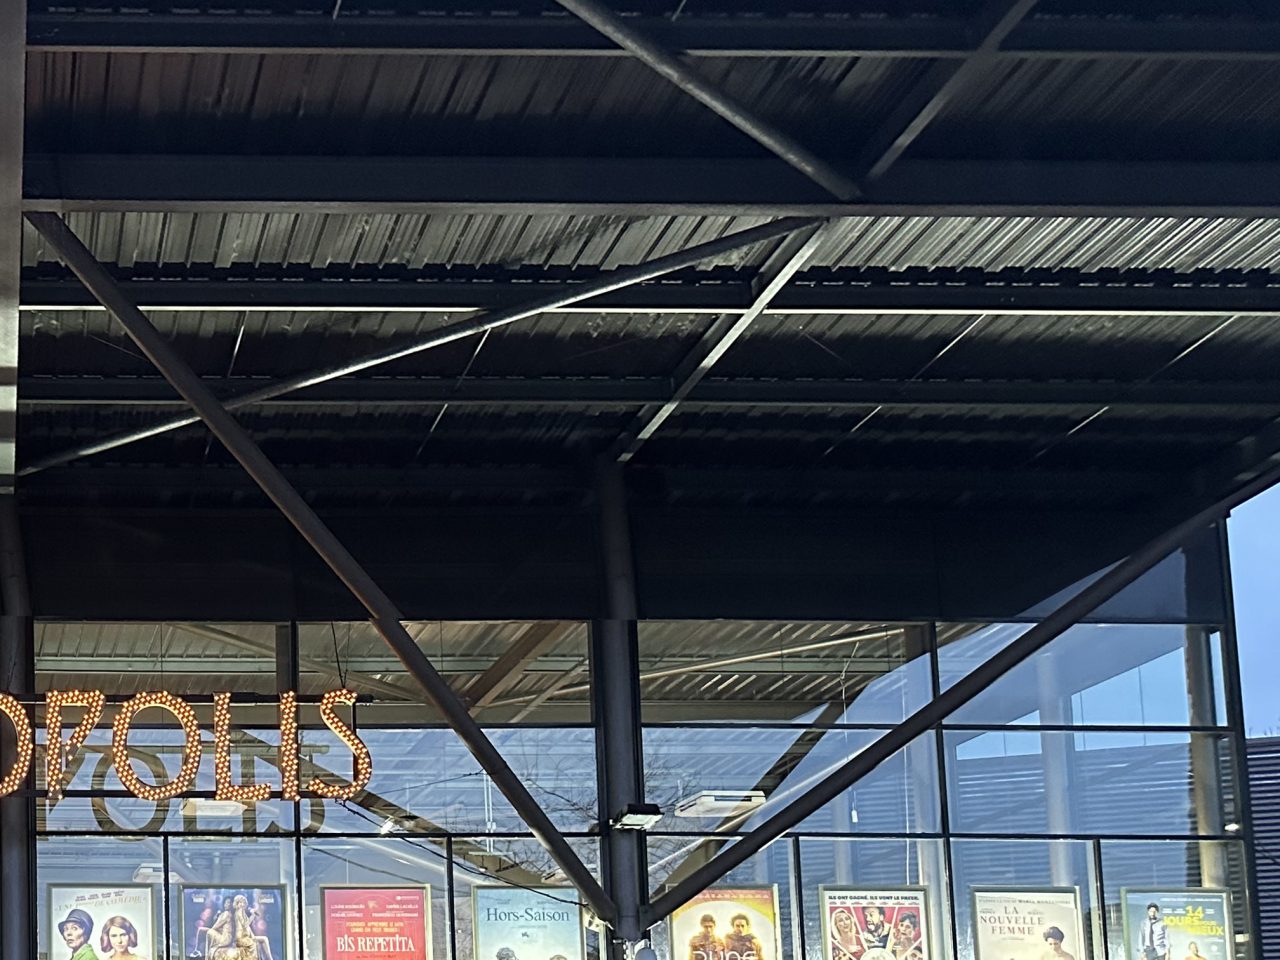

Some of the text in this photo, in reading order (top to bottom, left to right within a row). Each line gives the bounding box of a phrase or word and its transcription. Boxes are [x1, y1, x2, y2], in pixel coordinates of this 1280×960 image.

[486, 906, 570, 922] Hors-Saison
[1004, 906, 1019, 915] LA
[980, 916, 1045, 925] NOUVELLE
[991, 926, 1035, 935] FEMME
[357, 934, 416, 952] REPETITA
